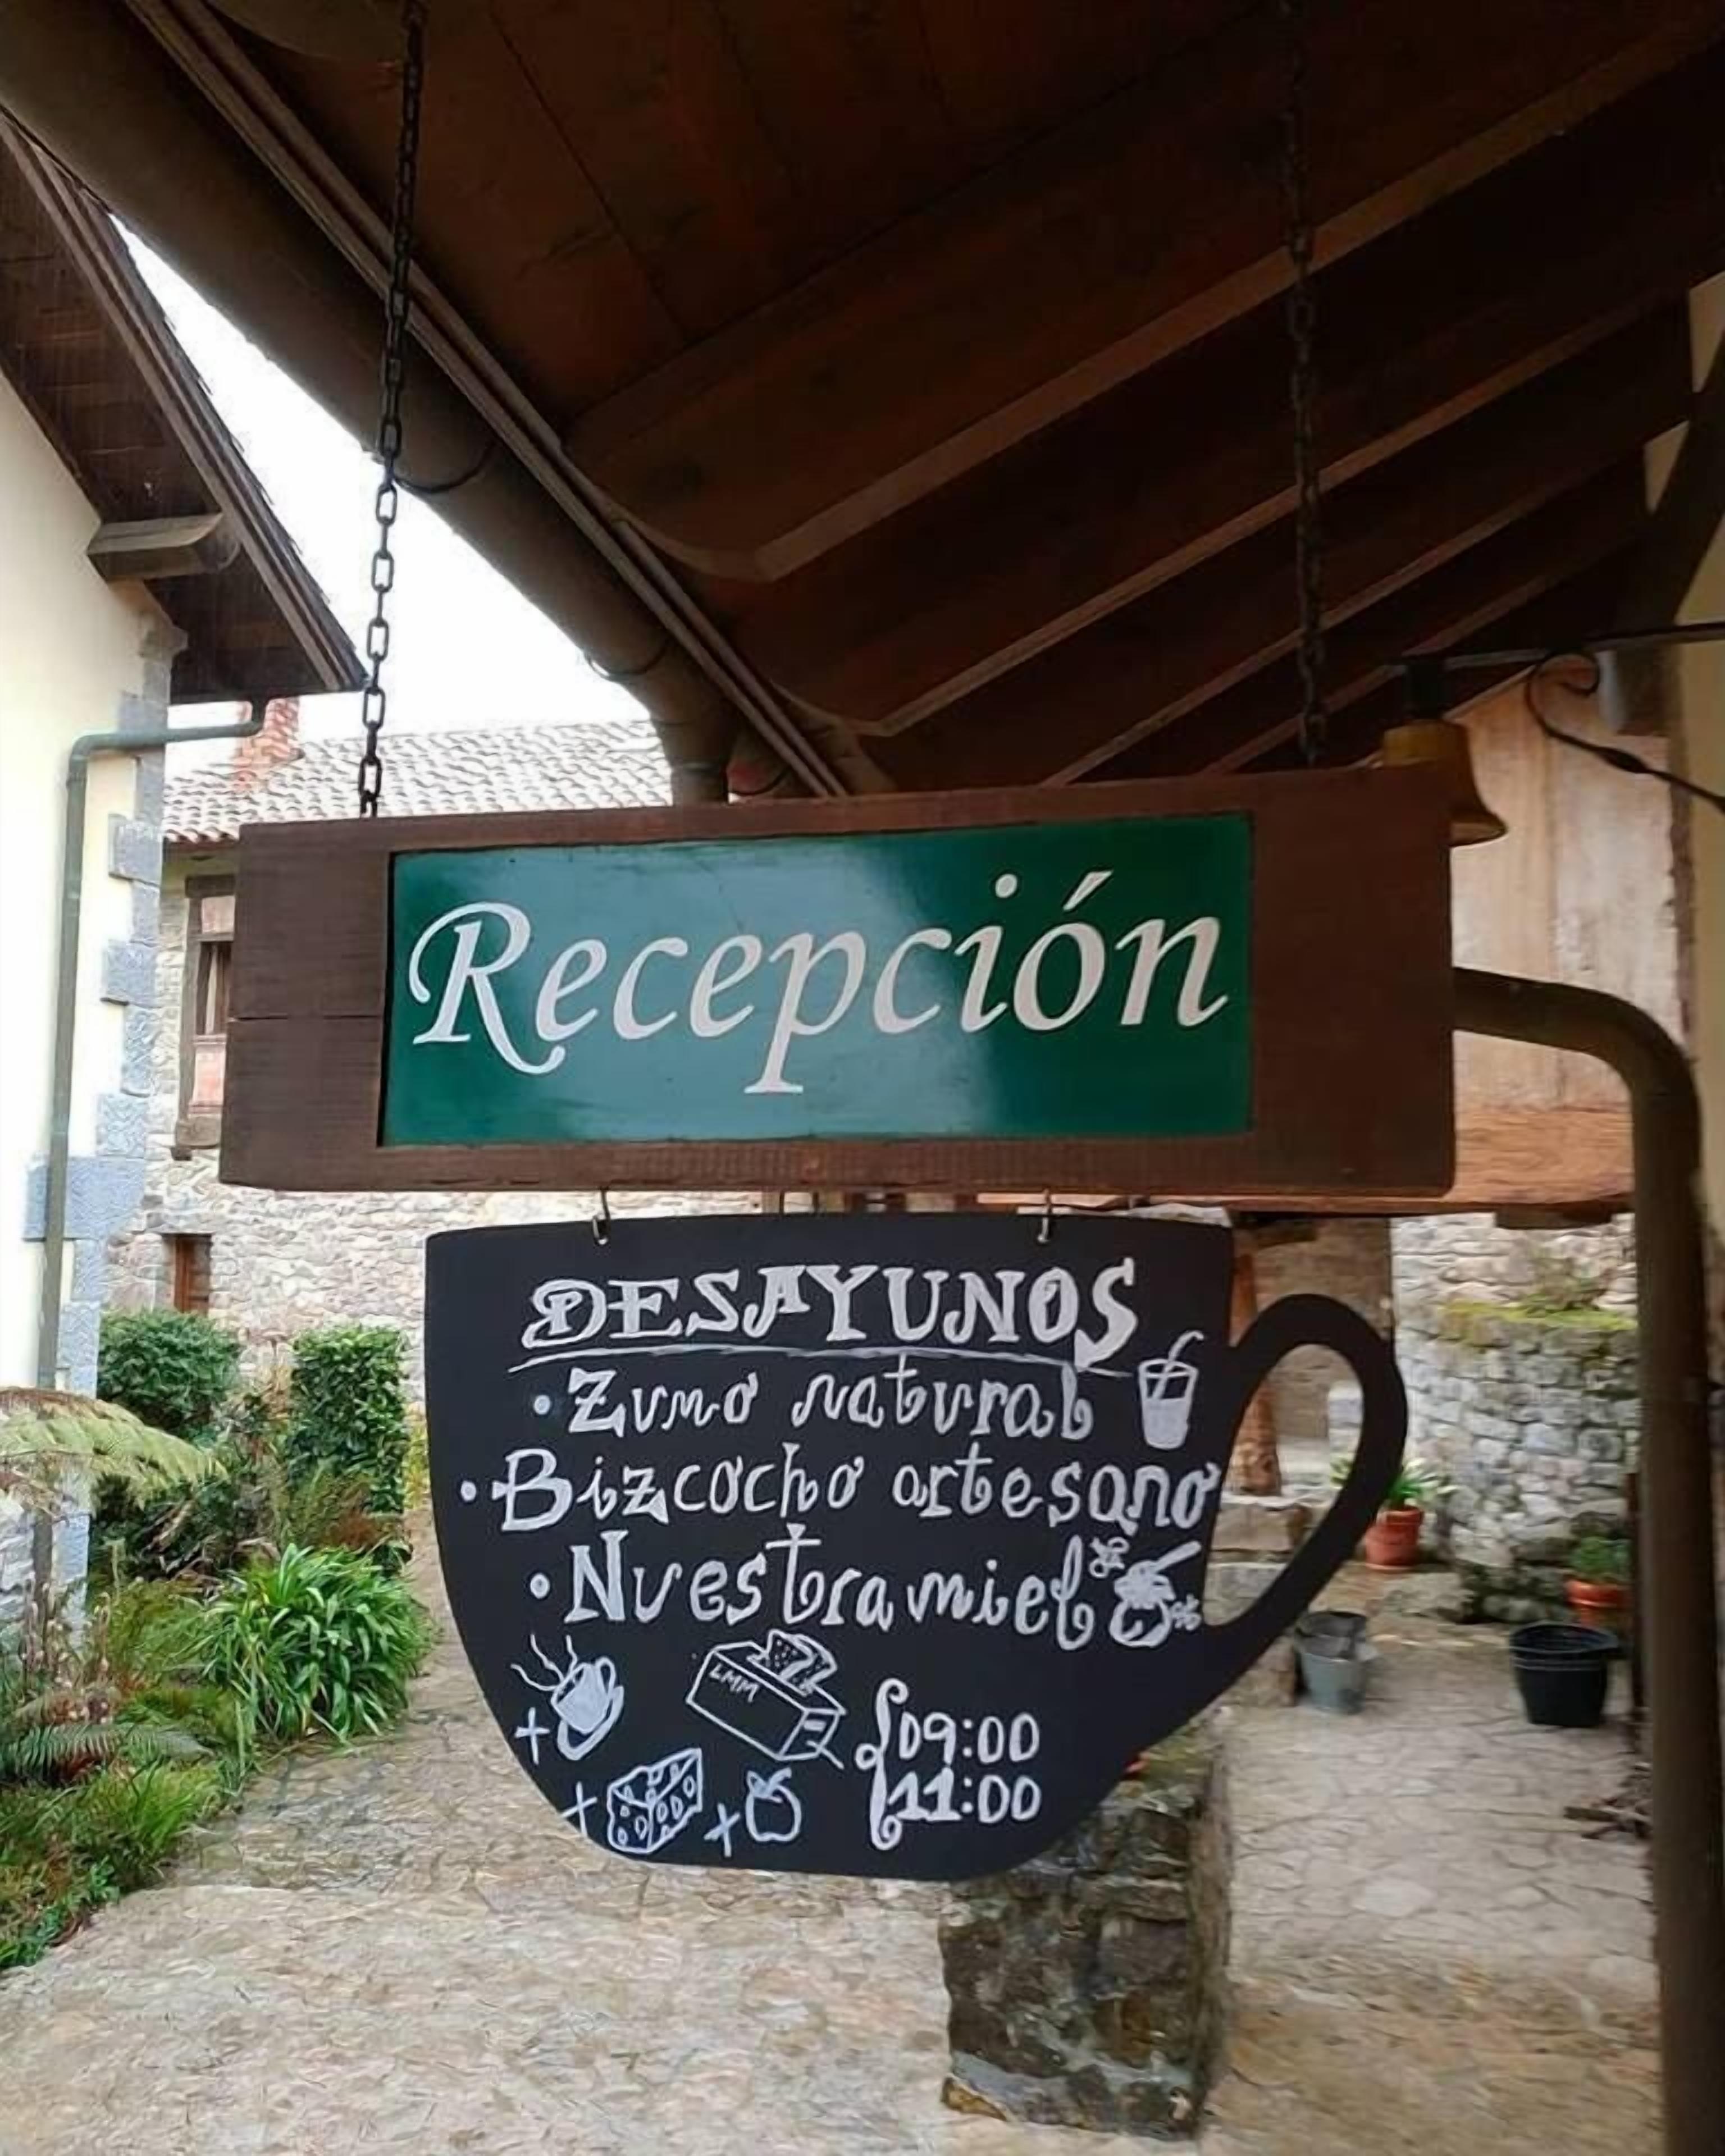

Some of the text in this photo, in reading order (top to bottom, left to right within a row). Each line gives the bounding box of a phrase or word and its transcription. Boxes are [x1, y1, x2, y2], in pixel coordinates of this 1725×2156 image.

[408, 870, 1230, 1094] Recepción
[521, 1257, 1138, 1376] DESAYUNOS
[567, 1354, 1094, 1441] Zumo natural
[491, 1441, 1222, 1536] Bizcocho artesano
[563, 1522, 1095, 1651] Nuestra miel
[898, 1711, 1040, 1765] 09:00
[888, 1766, 1042, 1824] 11:00
